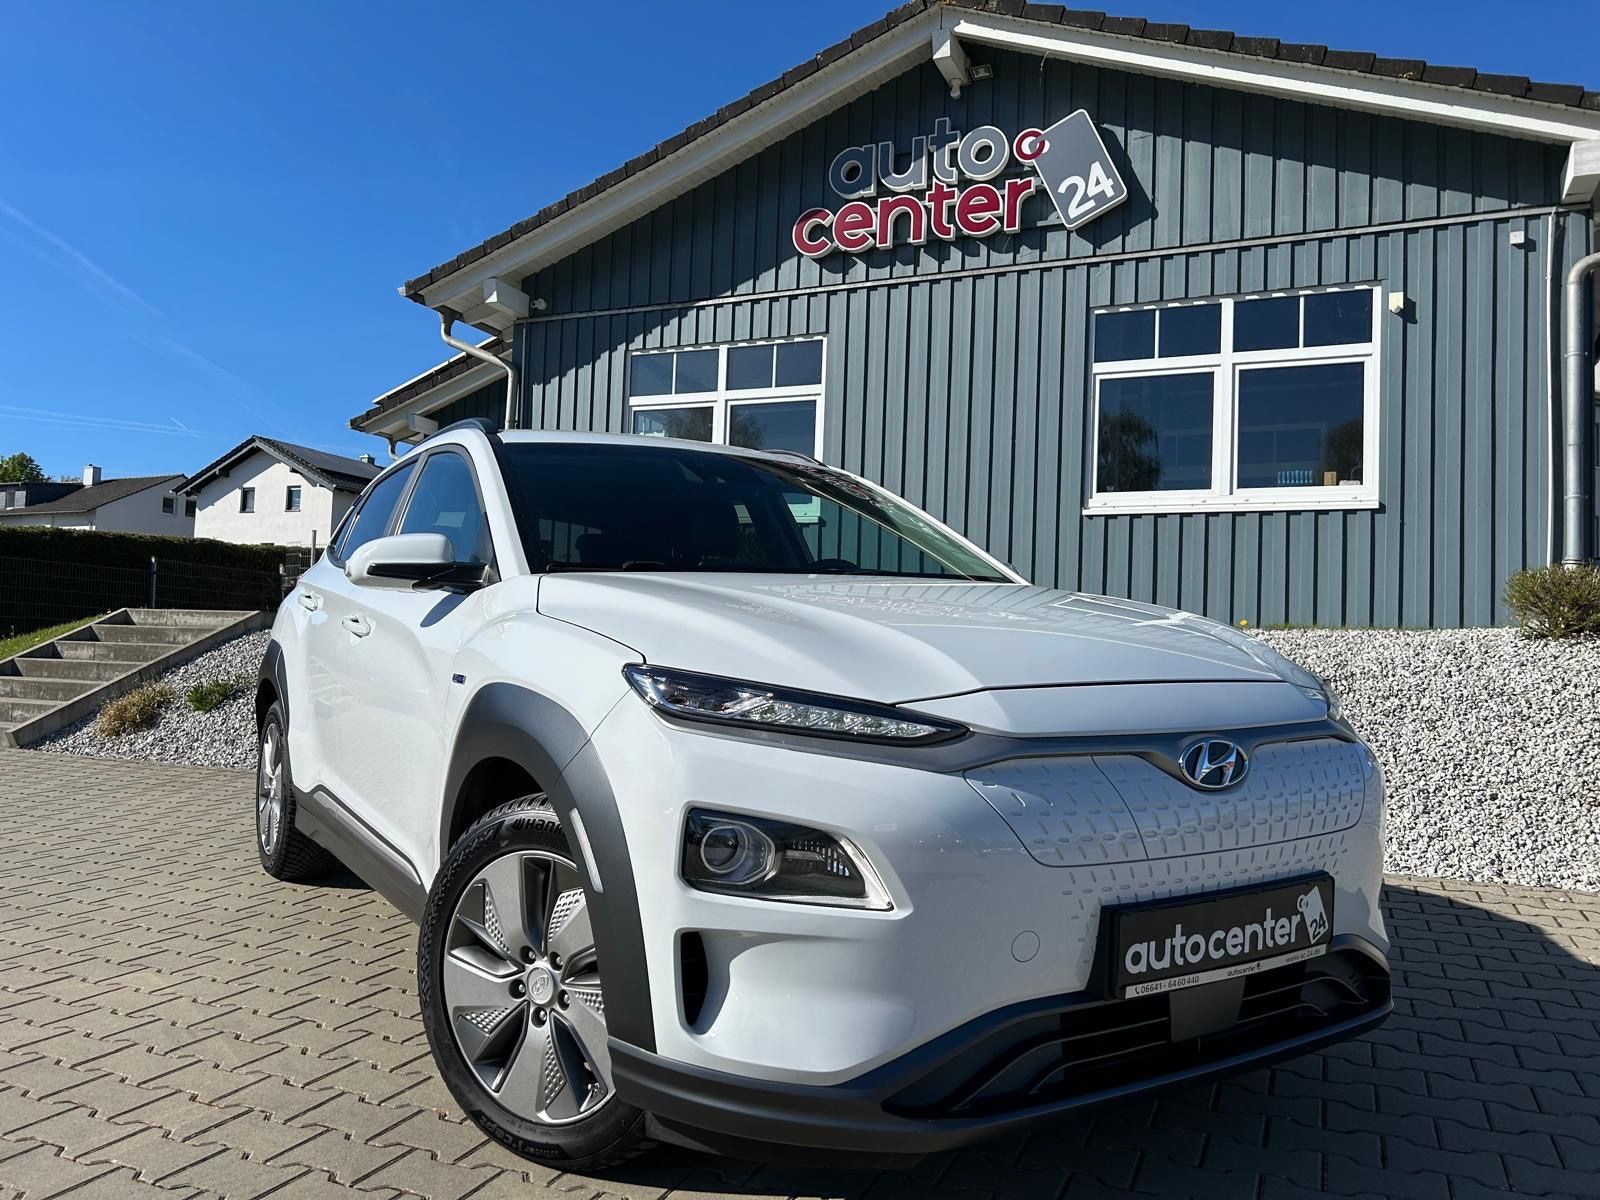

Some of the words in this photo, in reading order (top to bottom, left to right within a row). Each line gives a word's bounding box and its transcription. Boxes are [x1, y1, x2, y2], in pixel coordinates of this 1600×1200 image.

[829, 117, 1009, 199] auto
[1057, 160, 1115, 219] 24
[792, 176, 1035, 258] center
[1125, 907, 1300, 974] autocenter
[1310, 912, 1326, 939] 24
[1140, 982, 1163, 994] 06641
